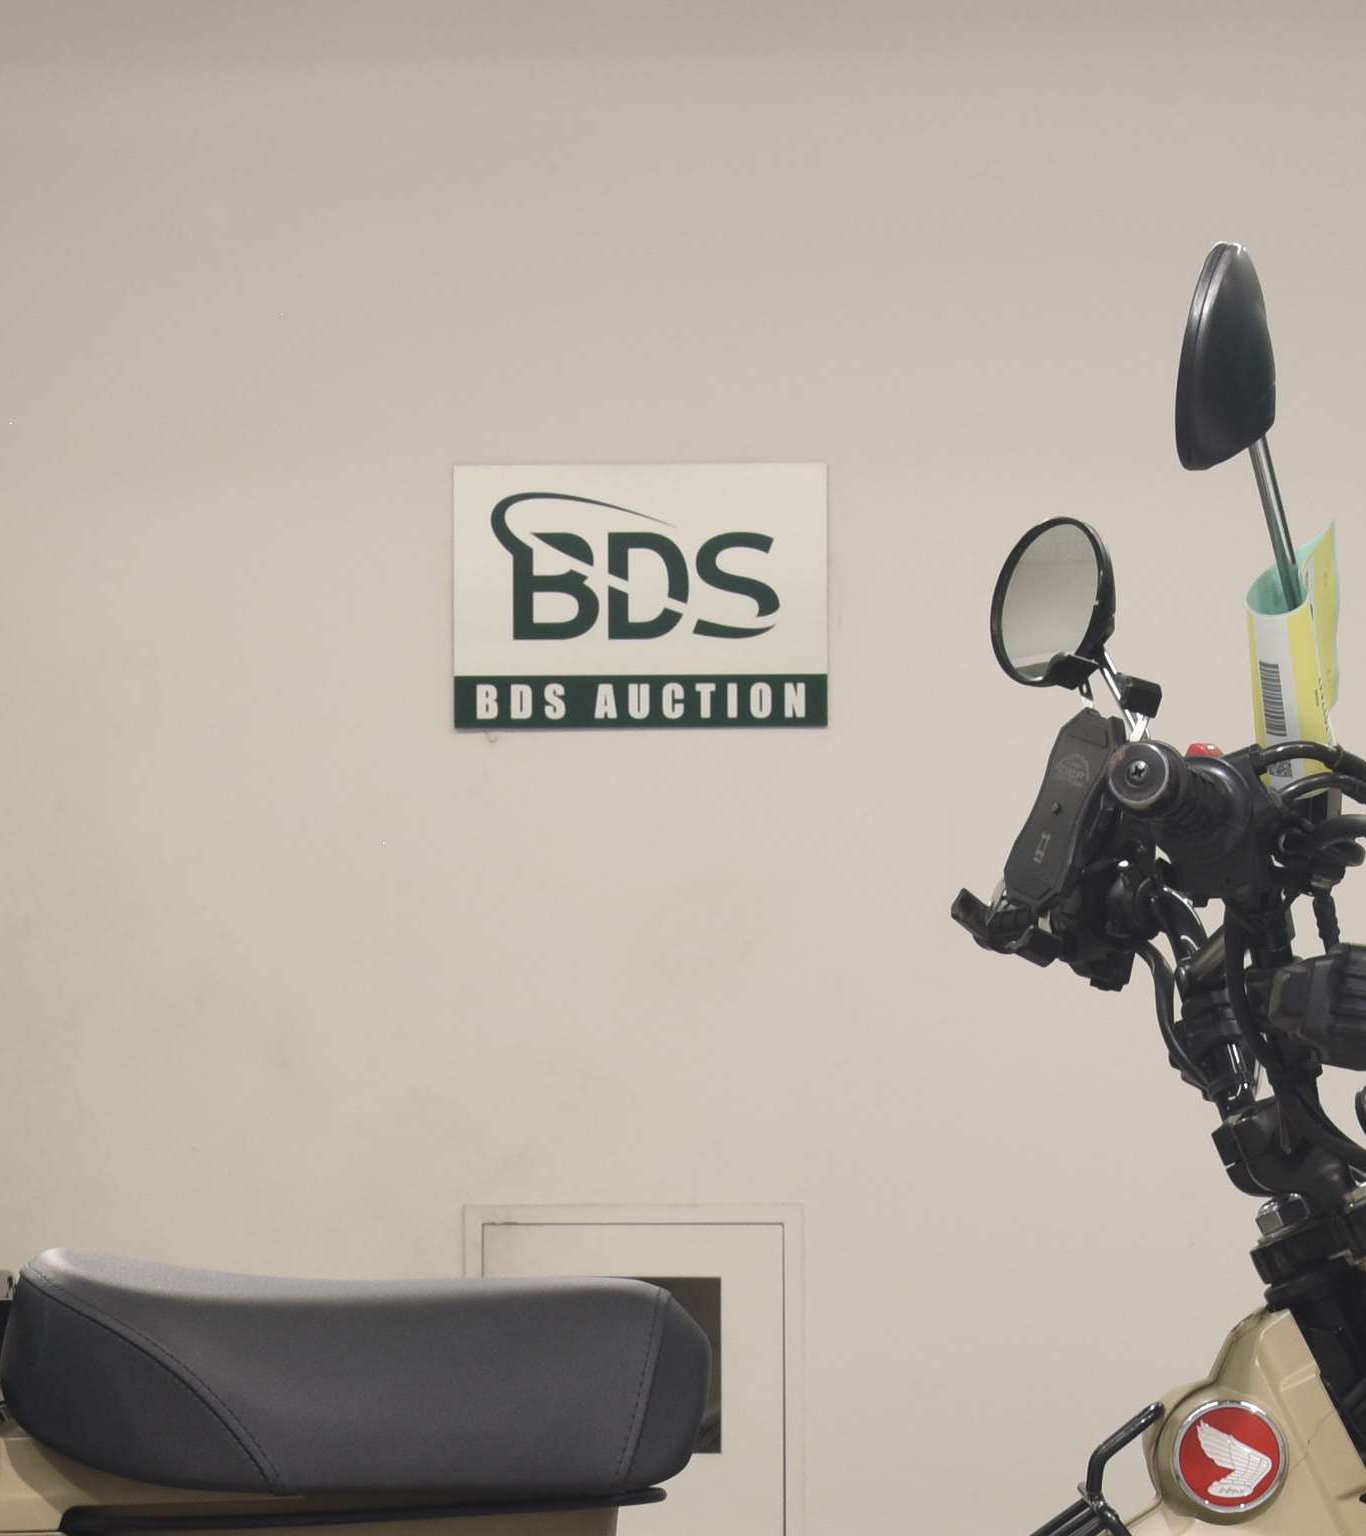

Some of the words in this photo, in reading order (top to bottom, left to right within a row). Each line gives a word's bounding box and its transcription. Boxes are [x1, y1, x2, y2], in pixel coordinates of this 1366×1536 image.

[491, 492, 781, 640] BDS
[476, 683, 567, 721] BDS
[594, 682, 807, 720] AUCTION
